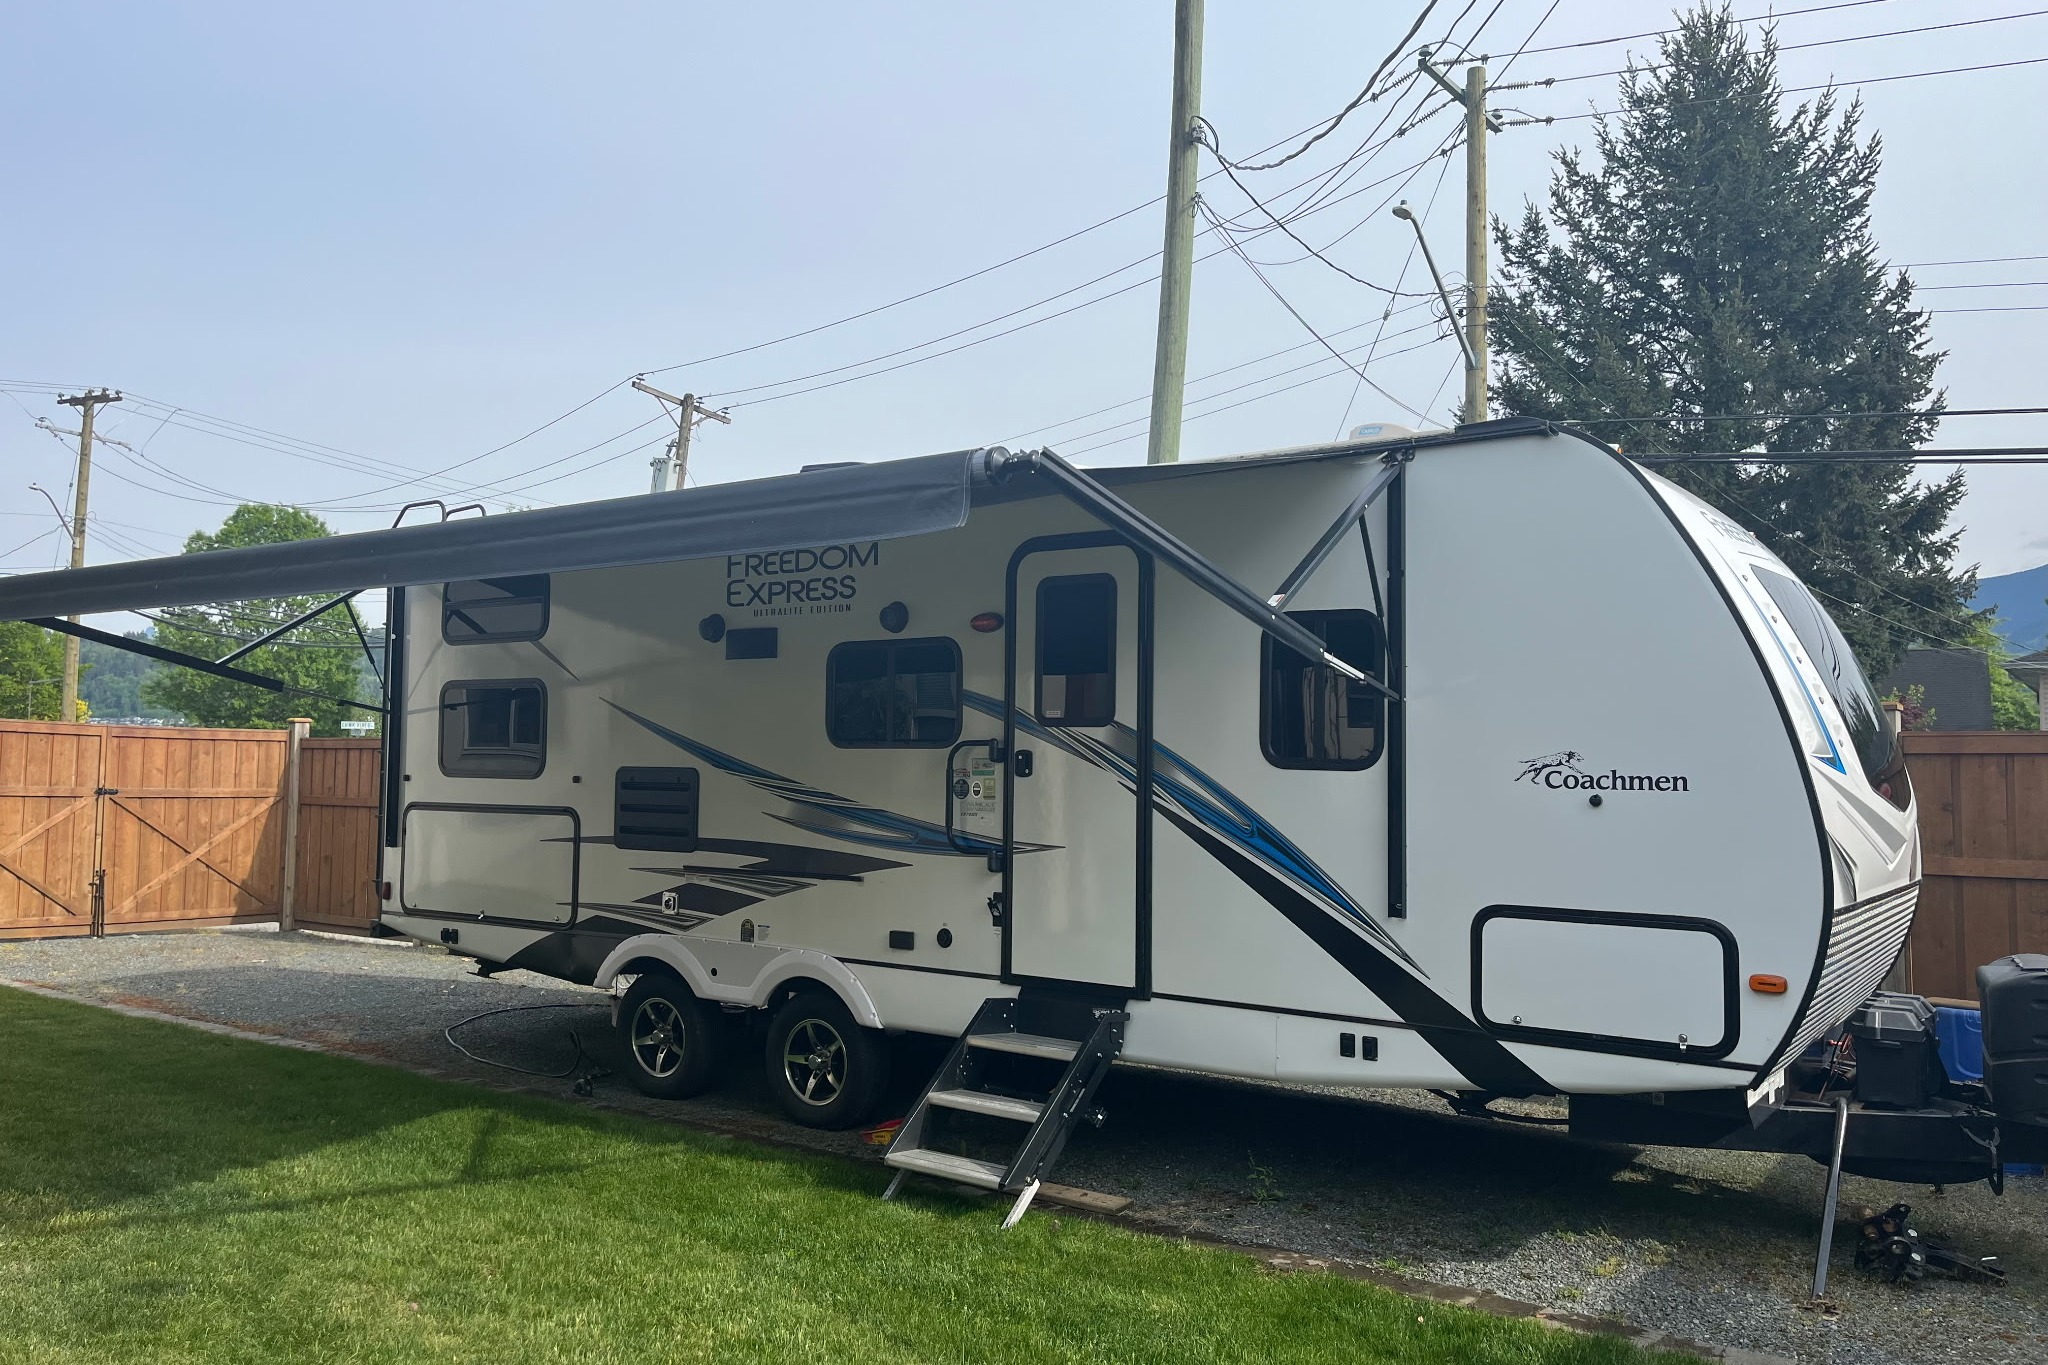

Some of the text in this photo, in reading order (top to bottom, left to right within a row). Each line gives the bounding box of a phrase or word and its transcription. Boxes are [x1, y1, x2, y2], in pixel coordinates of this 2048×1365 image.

[727, 542, 879, 578] FREEDOM
[726, 575, 857, 607] EXPRESS
[753, 603, 851, 618] ULTRALITE EDITION
[1544, 769, 1690, 792] Coachmen
